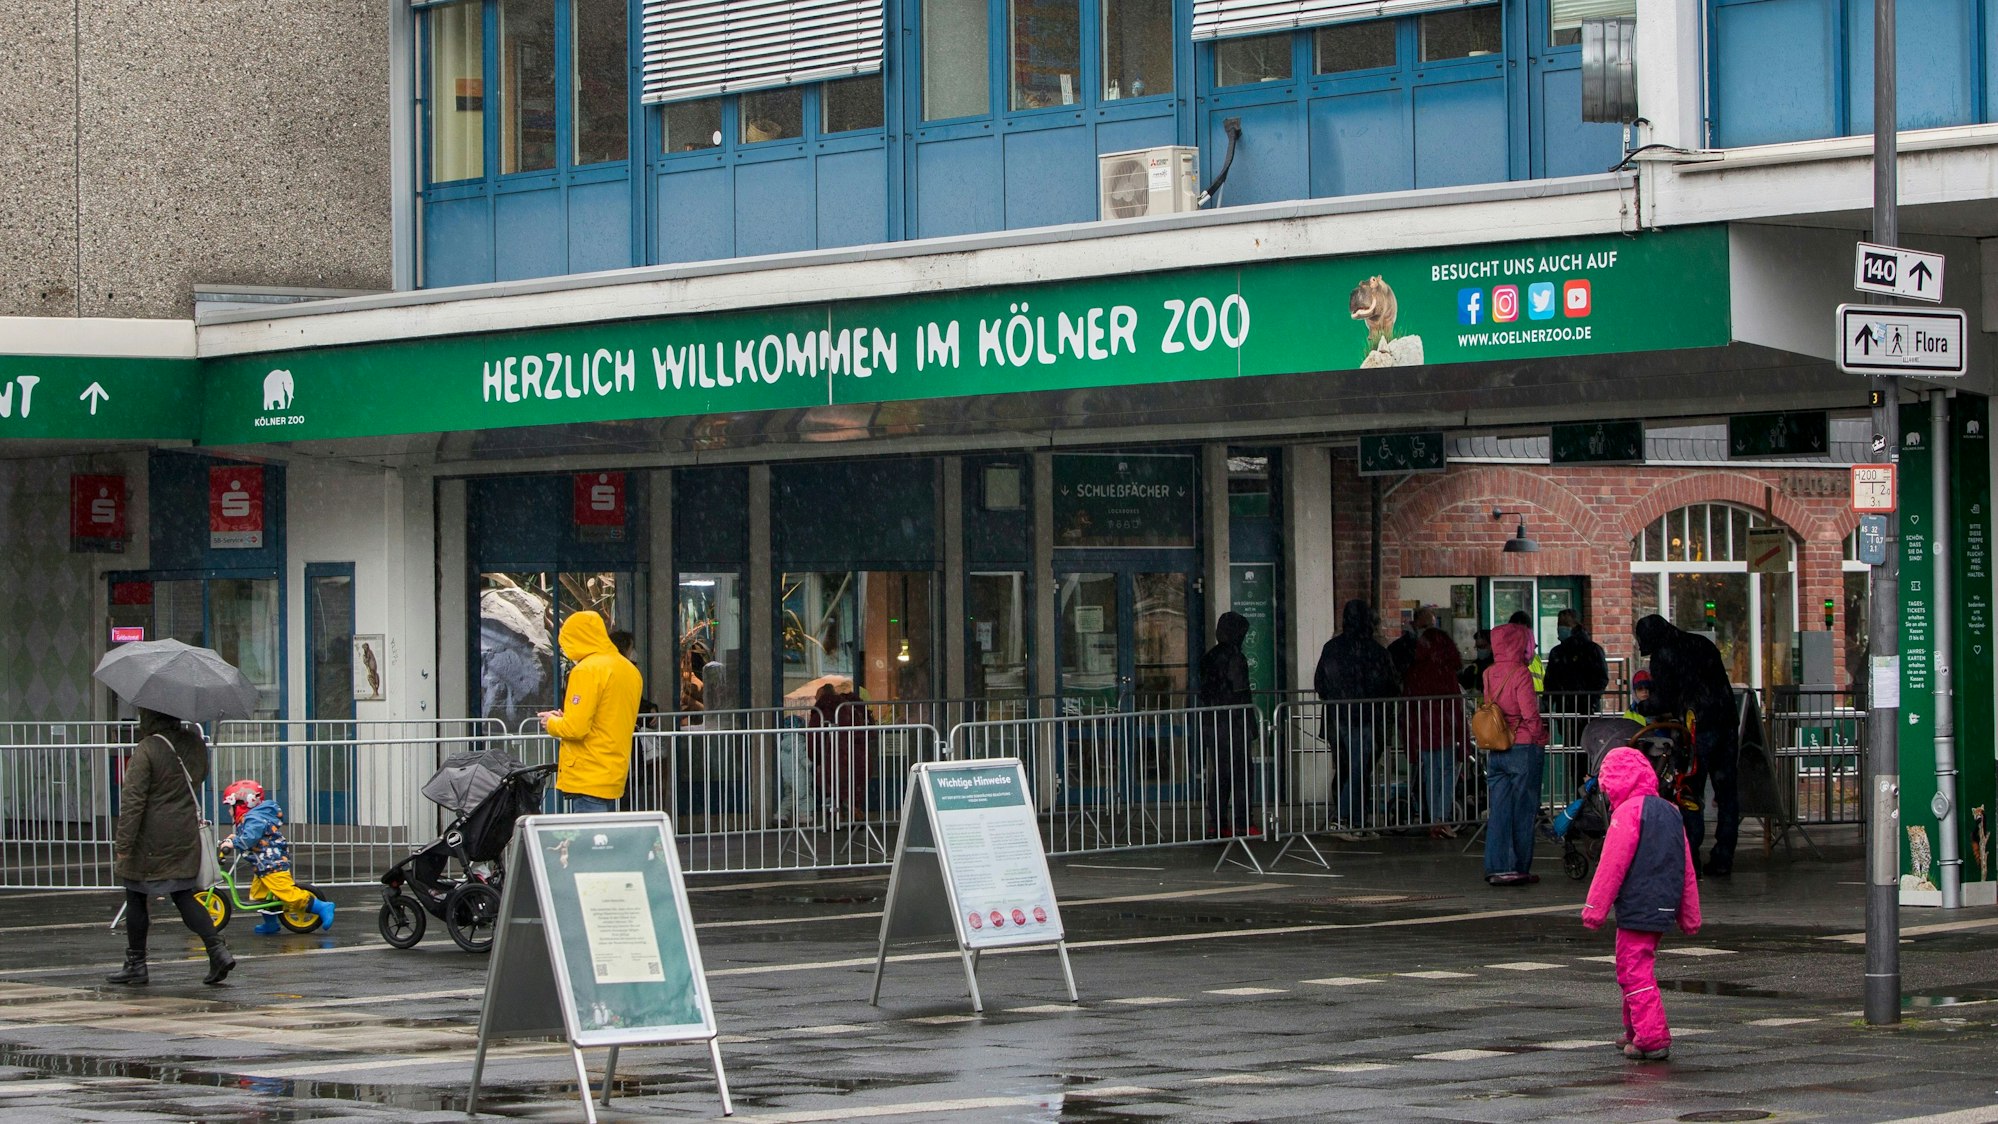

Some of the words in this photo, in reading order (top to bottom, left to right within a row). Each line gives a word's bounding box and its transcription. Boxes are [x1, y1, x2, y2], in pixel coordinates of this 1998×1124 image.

[1431, 260, 1500, 282] BESUCHT
[1503, 257, 1535, 275] UNS
[1538, 253, 1583, 274] AUCH
[1586, 250, 1618, 270] AUF
[1865, 257, 1896, 282] 140
[1457, 326, 1592, 348] WWW.KOELNERZOO.DE
[1915, 331, 1948, 353] Flora
[483, 348, 636, 404] HERZLICH
[651, 327, 897, 391] WILLKOMMEN
[916, 320, 960, 372] IM
[978, 301, 1138, 368] KÖLNER
[1161, 293, 1251, 354] ZOO
[1872, 392, 1878, 405] 3
[254, 416, 286, 427] KÖLNER
[287, 415, 305, 425] ZOO
[1854, 469, 1877, 481] H200
[1871, 525, 1878, 534] 32
[936, 776, 973, 789] Wichtige
[973, 774, 1011, 786] Hinweise
